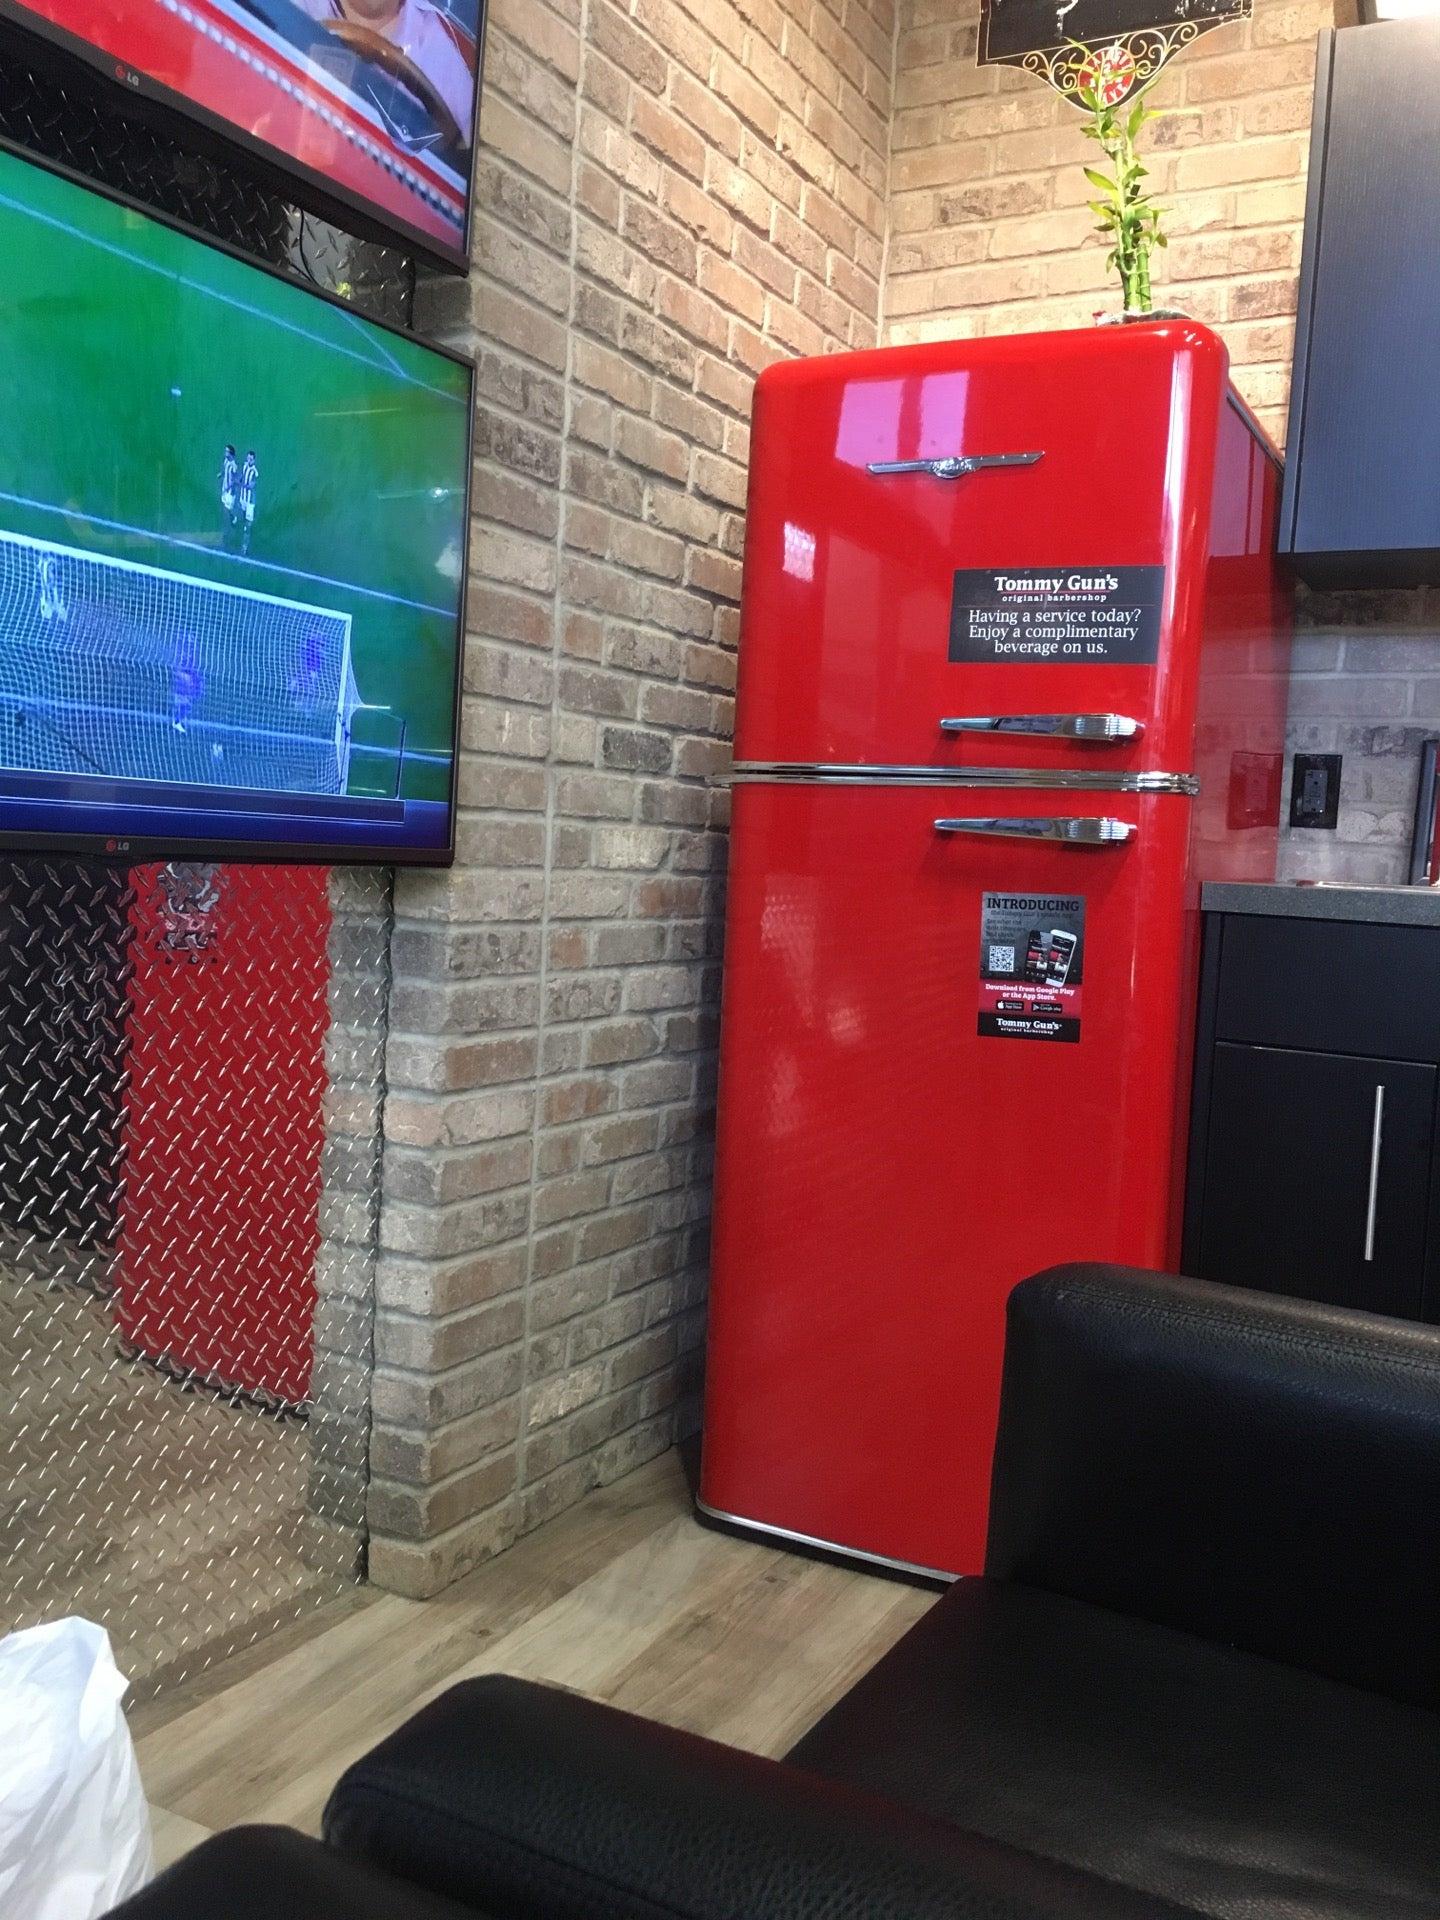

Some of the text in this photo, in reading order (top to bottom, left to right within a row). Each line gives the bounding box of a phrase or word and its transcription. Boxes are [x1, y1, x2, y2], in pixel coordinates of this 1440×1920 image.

[994, 573, 1119, 593] Tommy Gun's
[1002, 594, 1107, 603] original barbershop
[968, 608, 1141, 625] Having a service today?
[969, 624, 1139, 640] Enjoy a complimentary
[994, 640, 1108, 656] beverage on us.
[987, 897, 1079, 912] INTRODUCING
[985, 983, 1075, 997] Download from Google Play
[996, 1017, 1060, 1030] Tommy Gun's
